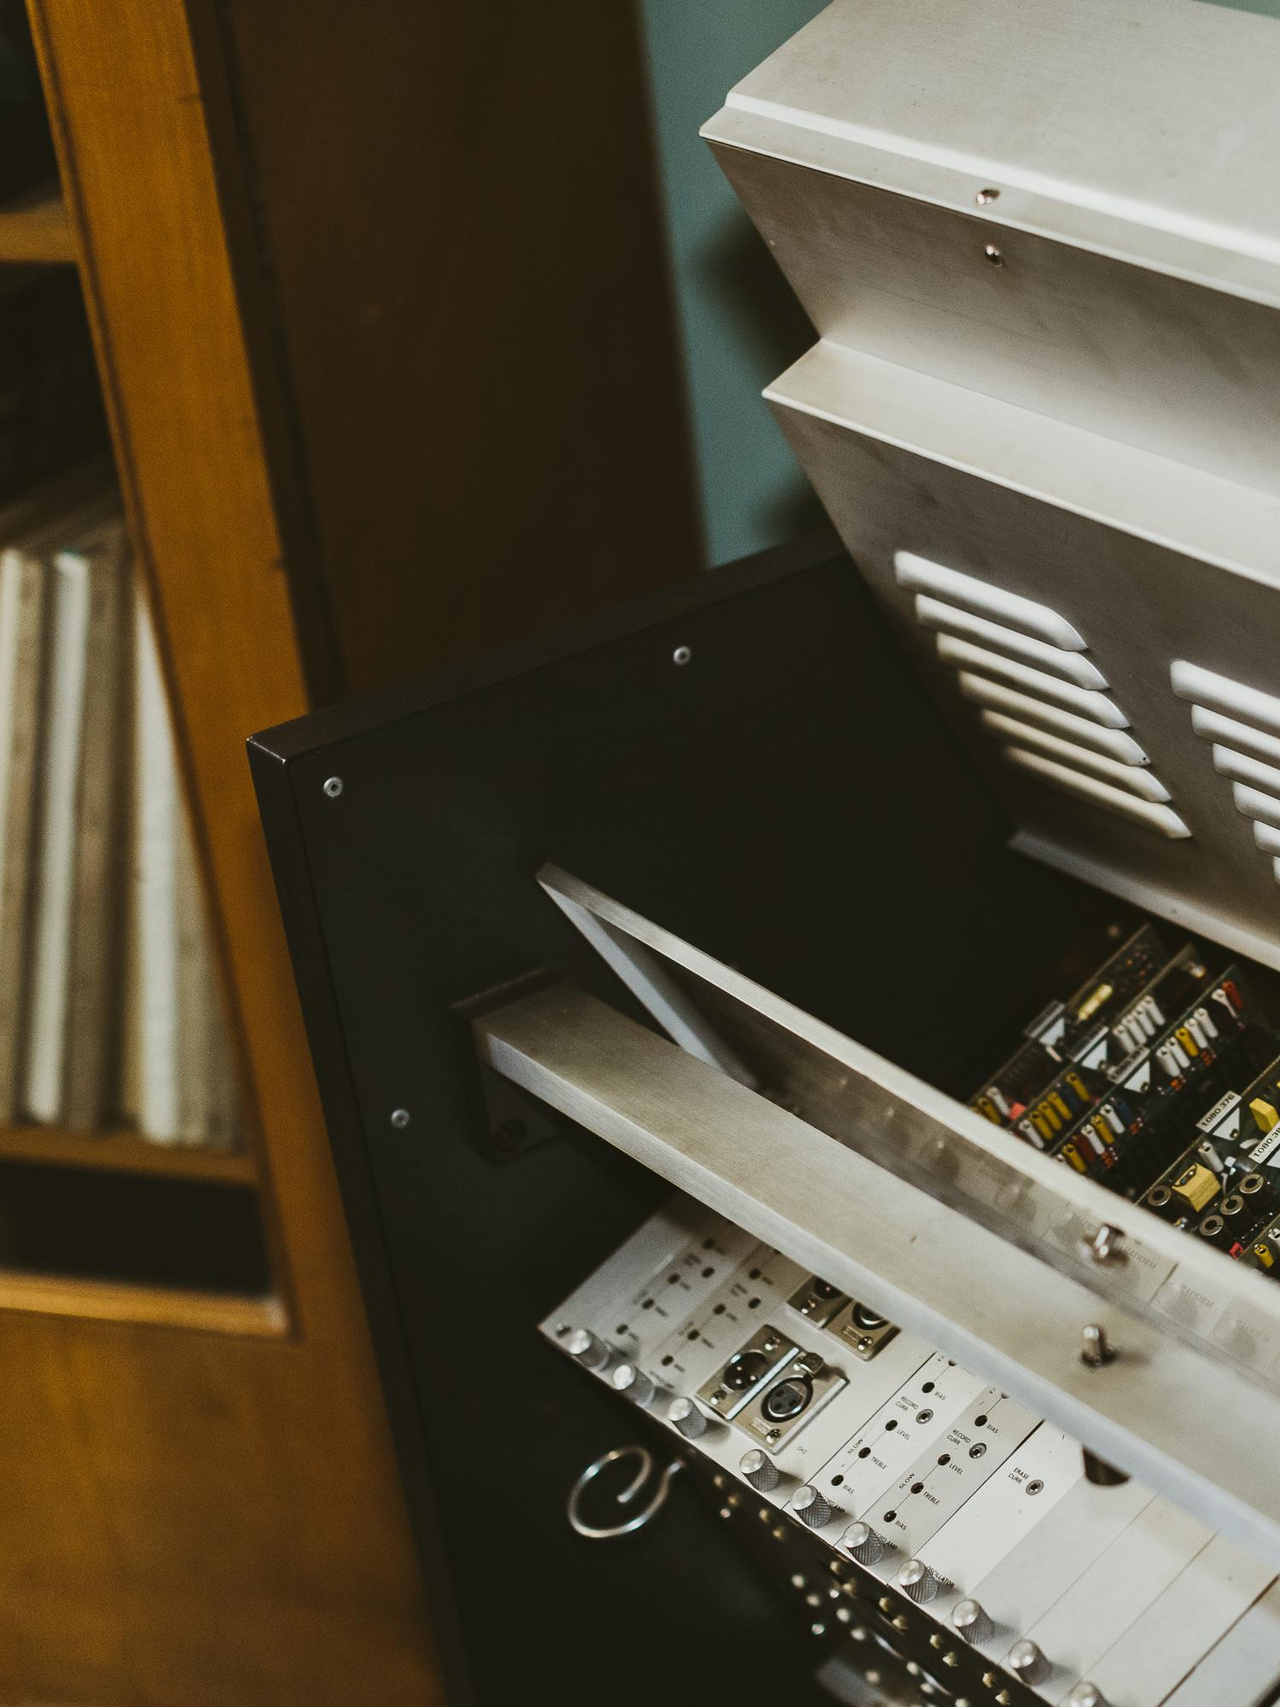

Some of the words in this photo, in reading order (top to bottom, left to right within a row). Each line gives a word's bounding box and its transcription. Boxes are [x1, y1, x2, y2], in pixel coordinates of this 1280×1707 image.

[934, 1390, 947, 1401] BIAS
[901, 1395, 919, 1410] RECORD
[986, 1423, 1000, 1434] BIAS
[897, 1429, 910, 1441] LEVEL
[946, 1434, 961, 1446] CURR
[951, 1428, 972, 1444] RECORD
[847, 1438, 863, 1455] SLOW
[871, 1456, 888, 1470] TREBLE
[948, 1463, 964, 1475] LEVEL
[1008, 1473, 1023, 1485] CURR
[1013, 1467, 1030, 1480] ERASE
[898, 1472, 915, 1490] SLOW
[842, 1484, 855, 1495] BIAS
[923, 1491, 941, 1506] TREBLE
[895, 1520, 908, 1531] BIAS
[926, 1565, 955, 1588] OSCILLATOR
